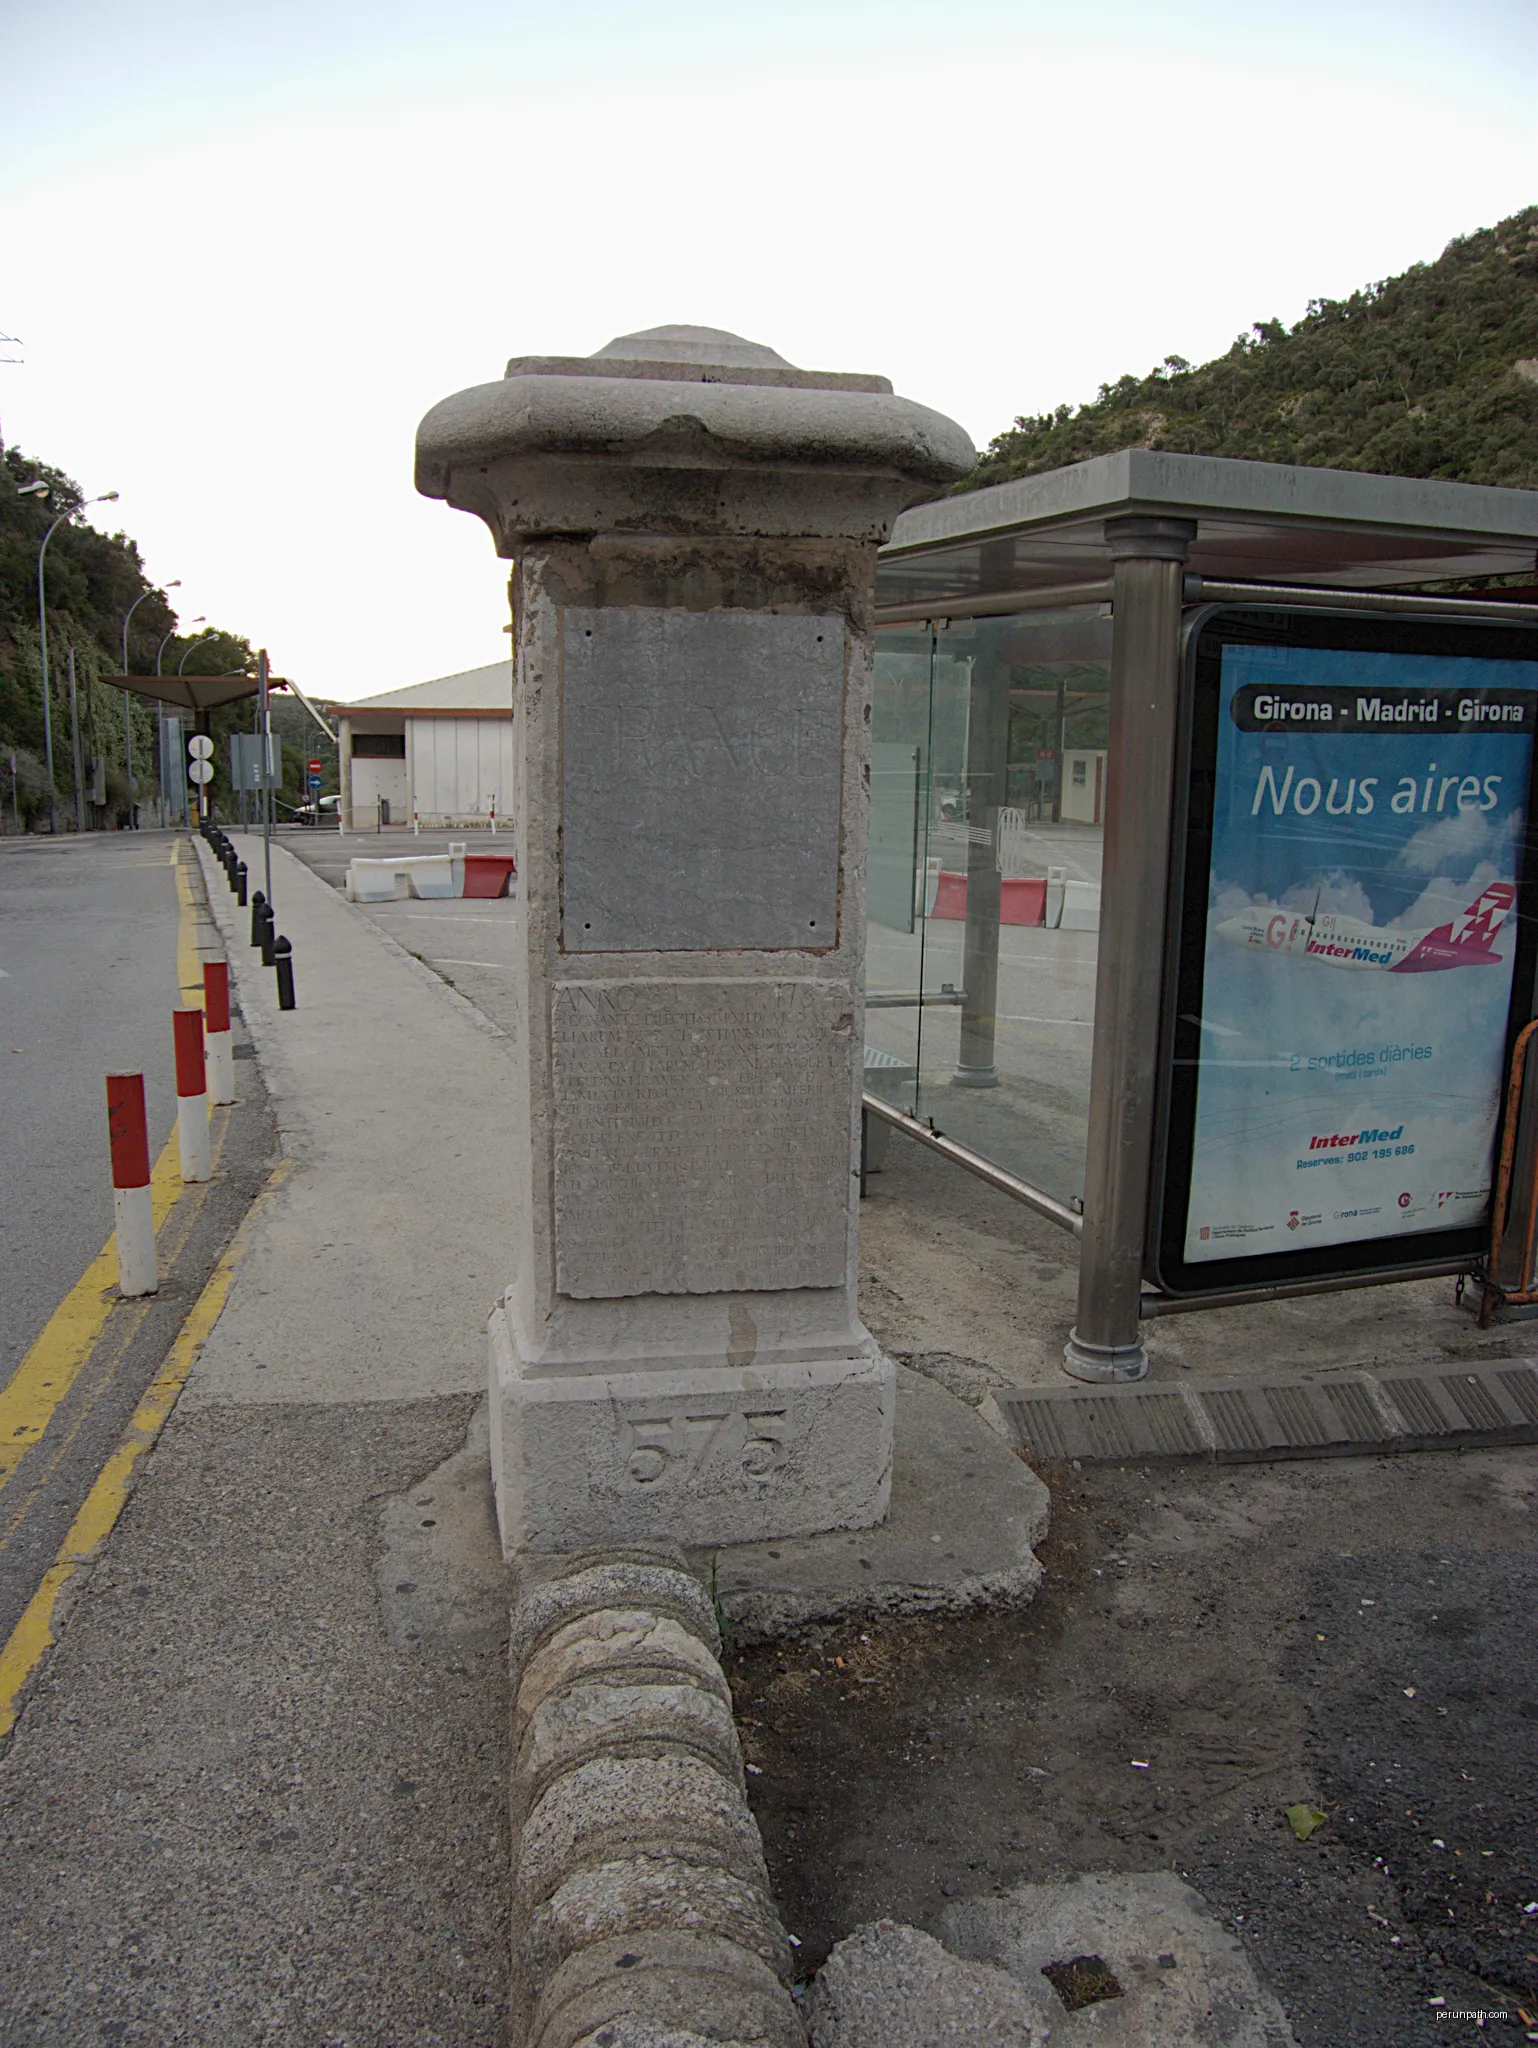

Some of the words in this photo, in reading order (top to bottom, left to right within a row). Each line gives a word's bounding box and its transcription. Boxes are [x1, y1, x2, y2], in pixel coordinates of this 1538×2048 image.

[1254, 695, 1333, 720] Girona
[1356, 697, 1438, 722] Madrid
[1457, 699, 1524, 722] Girona
[1251, 765, 1378, 815] Nous
[1390, 763, 1502, 813] aires
[1306, 940, 1393, 964] InterMed
[552, 984, 637, 1012] ANNO
[1289, 1053, 1301, 1072] 2
[1307, 1049, 1375, 1070] sortides
[1379, 1044, 1433, 1063] diàries
[1309, 1125, 1404, 1150] InterMed
[1296, 1156, 1344, 1170] Reserves:
[1347, 1151, 1368, 1163] 902
[1372, 1148, 1392, 1159] 195
[628, 1408, 787, 1484] 575
